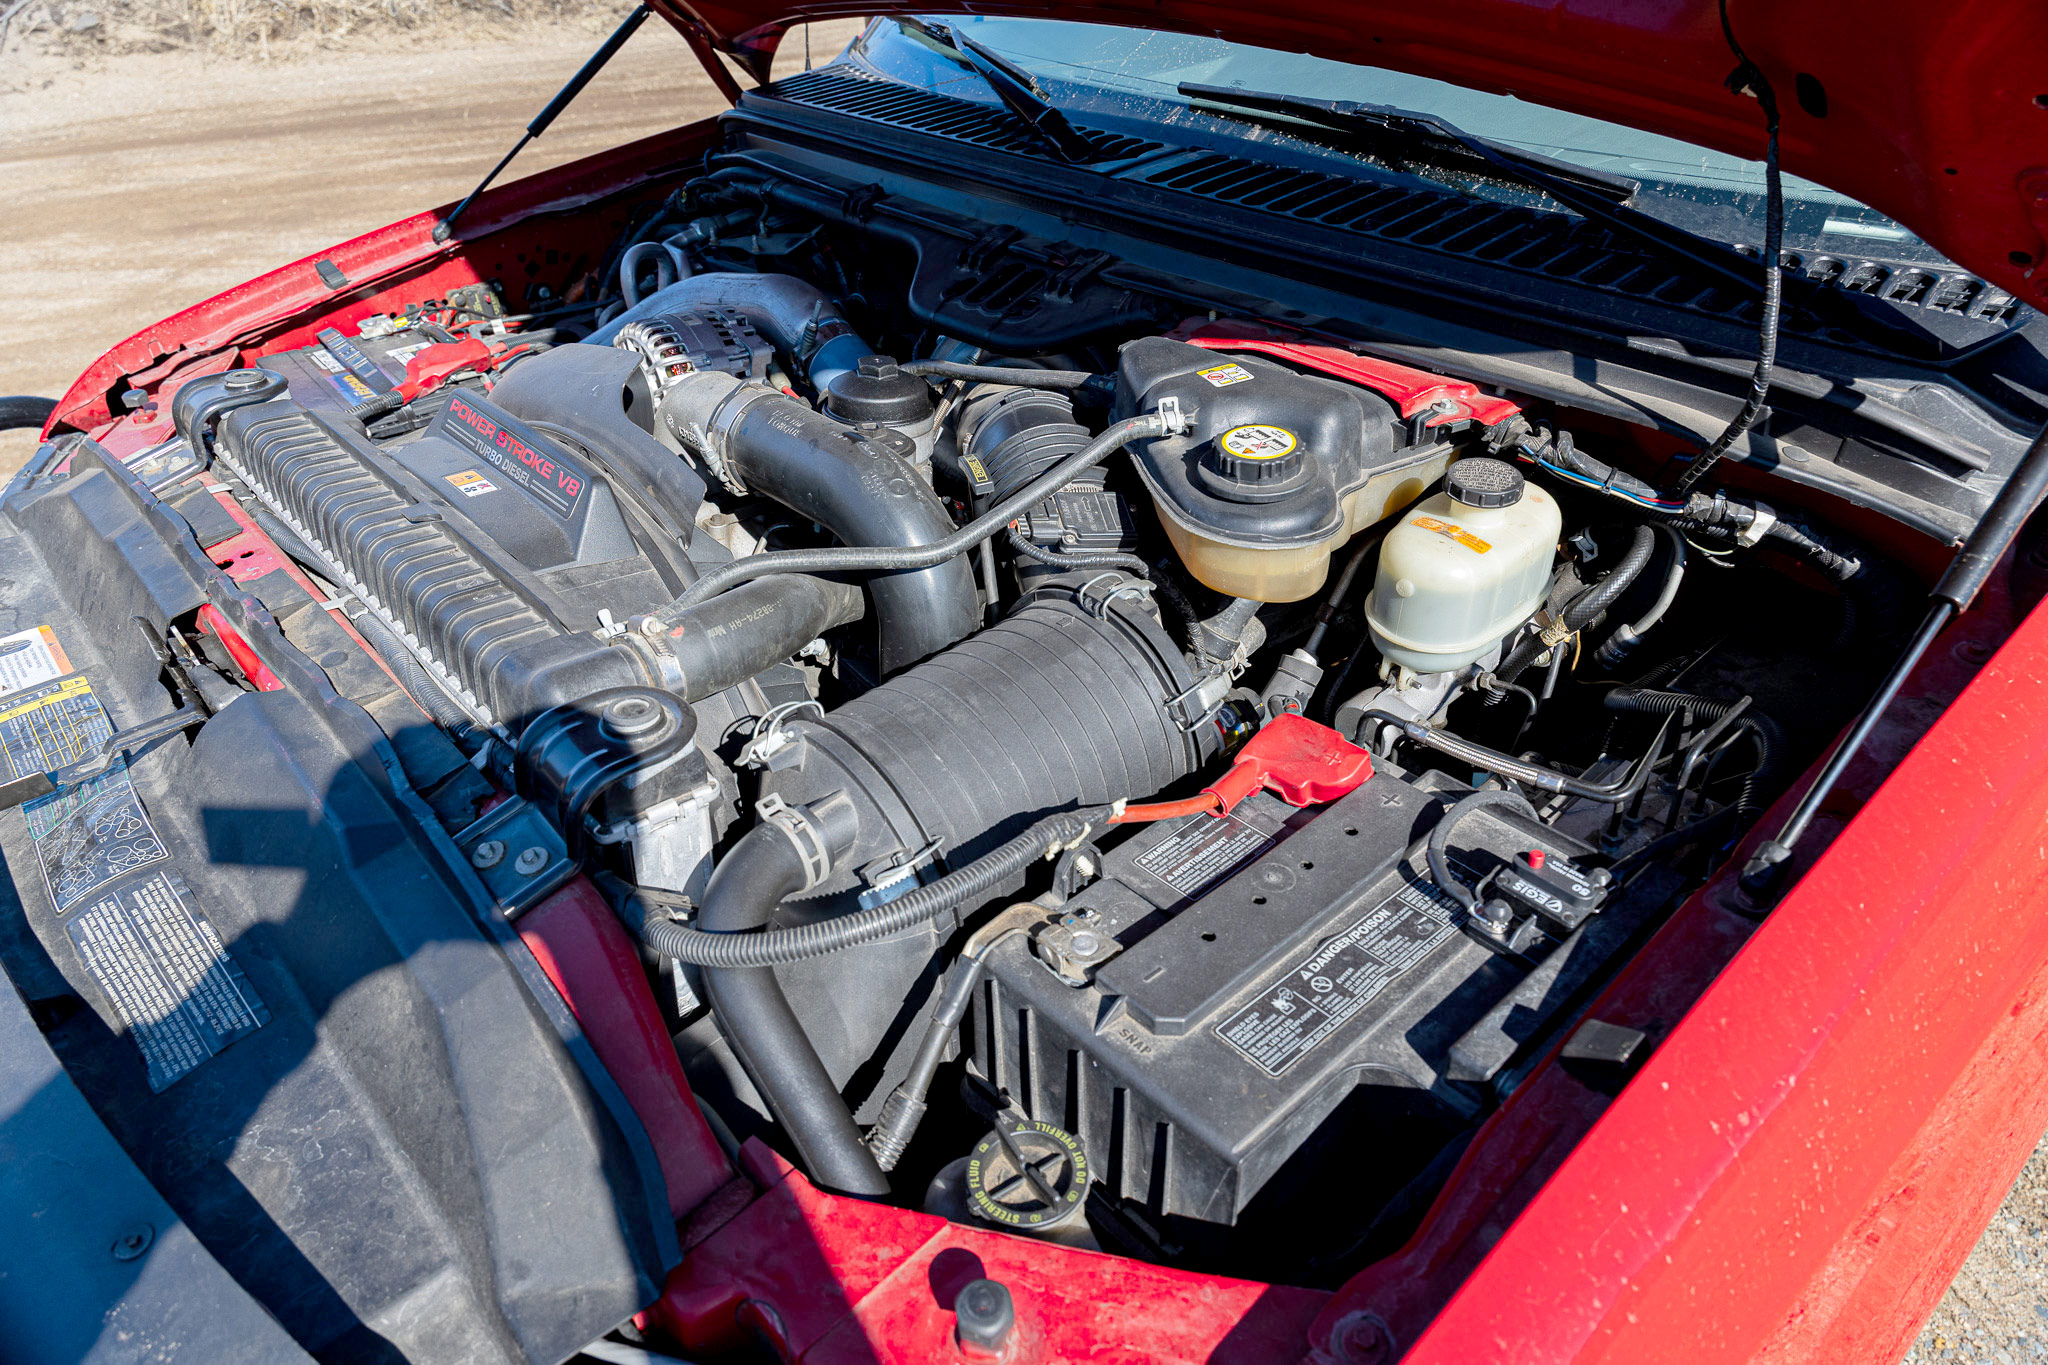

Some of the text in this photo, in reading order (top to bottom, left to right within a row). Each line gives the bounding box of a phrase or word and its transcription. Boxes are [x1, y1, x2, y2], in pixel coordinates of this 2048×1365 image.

[449, 398, 580, 497] POWER STROKE V8
[475, 439, 531, 488] TURBO DIESEL
[1144, 835, 1182, 860] WARNING
[1168, 835, 1232, 877] AVERTISSEMENT
[1512, 880, 1548, 905] EGIS
[1572, 883, 1591, 897] 50
[198, 919, 230, 963] MODIFICATIONS
[1306, 907, 1391, 972] DANGER/POISON
[1118, 1027, 1152, 1056] SNAP
[1035, 1122, 1087, 1184] DO NOT OVERFILL
[969, 1159, 1020, 1224] STEERING FLUID
